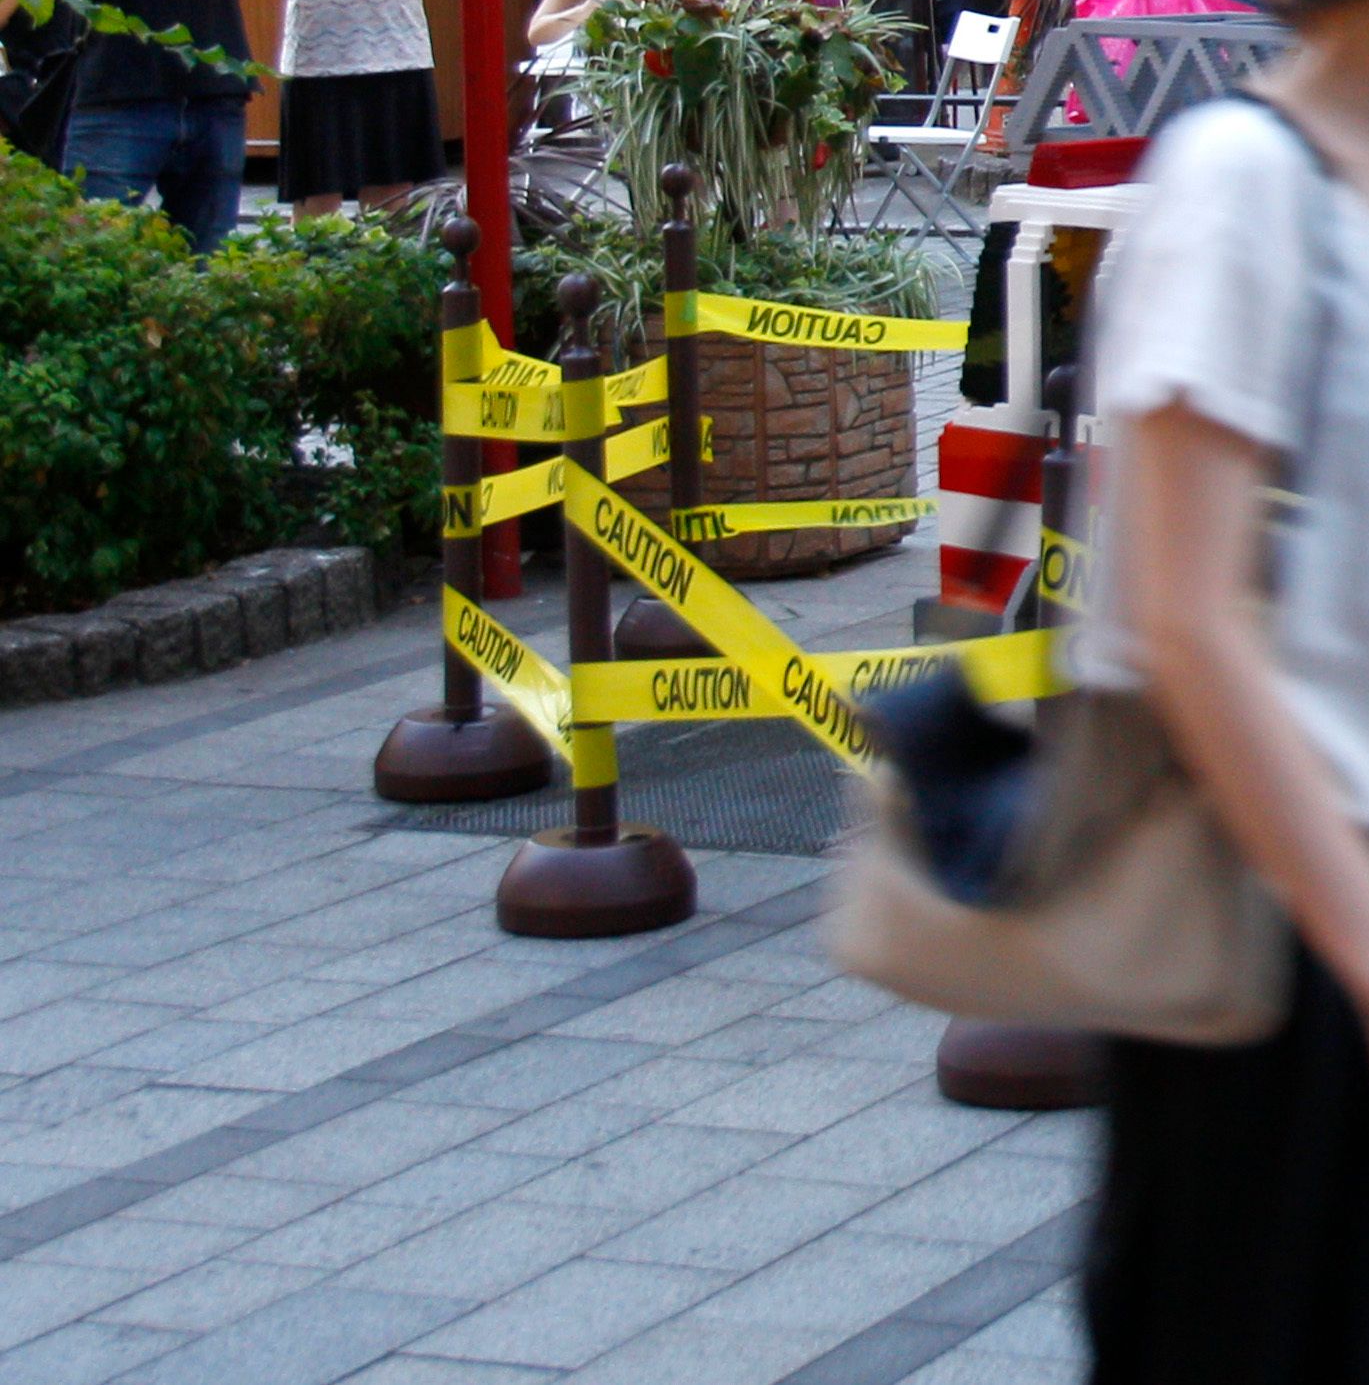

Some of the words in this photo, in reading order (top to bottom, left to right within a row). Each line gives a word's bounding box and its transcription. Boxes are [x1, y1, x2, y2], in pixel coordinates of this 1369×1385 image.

[595, 496, 695, 605] CAUTION
[457, 605, 524, 684] CAUTION
[652, 667, 750, 712] CAUTION
